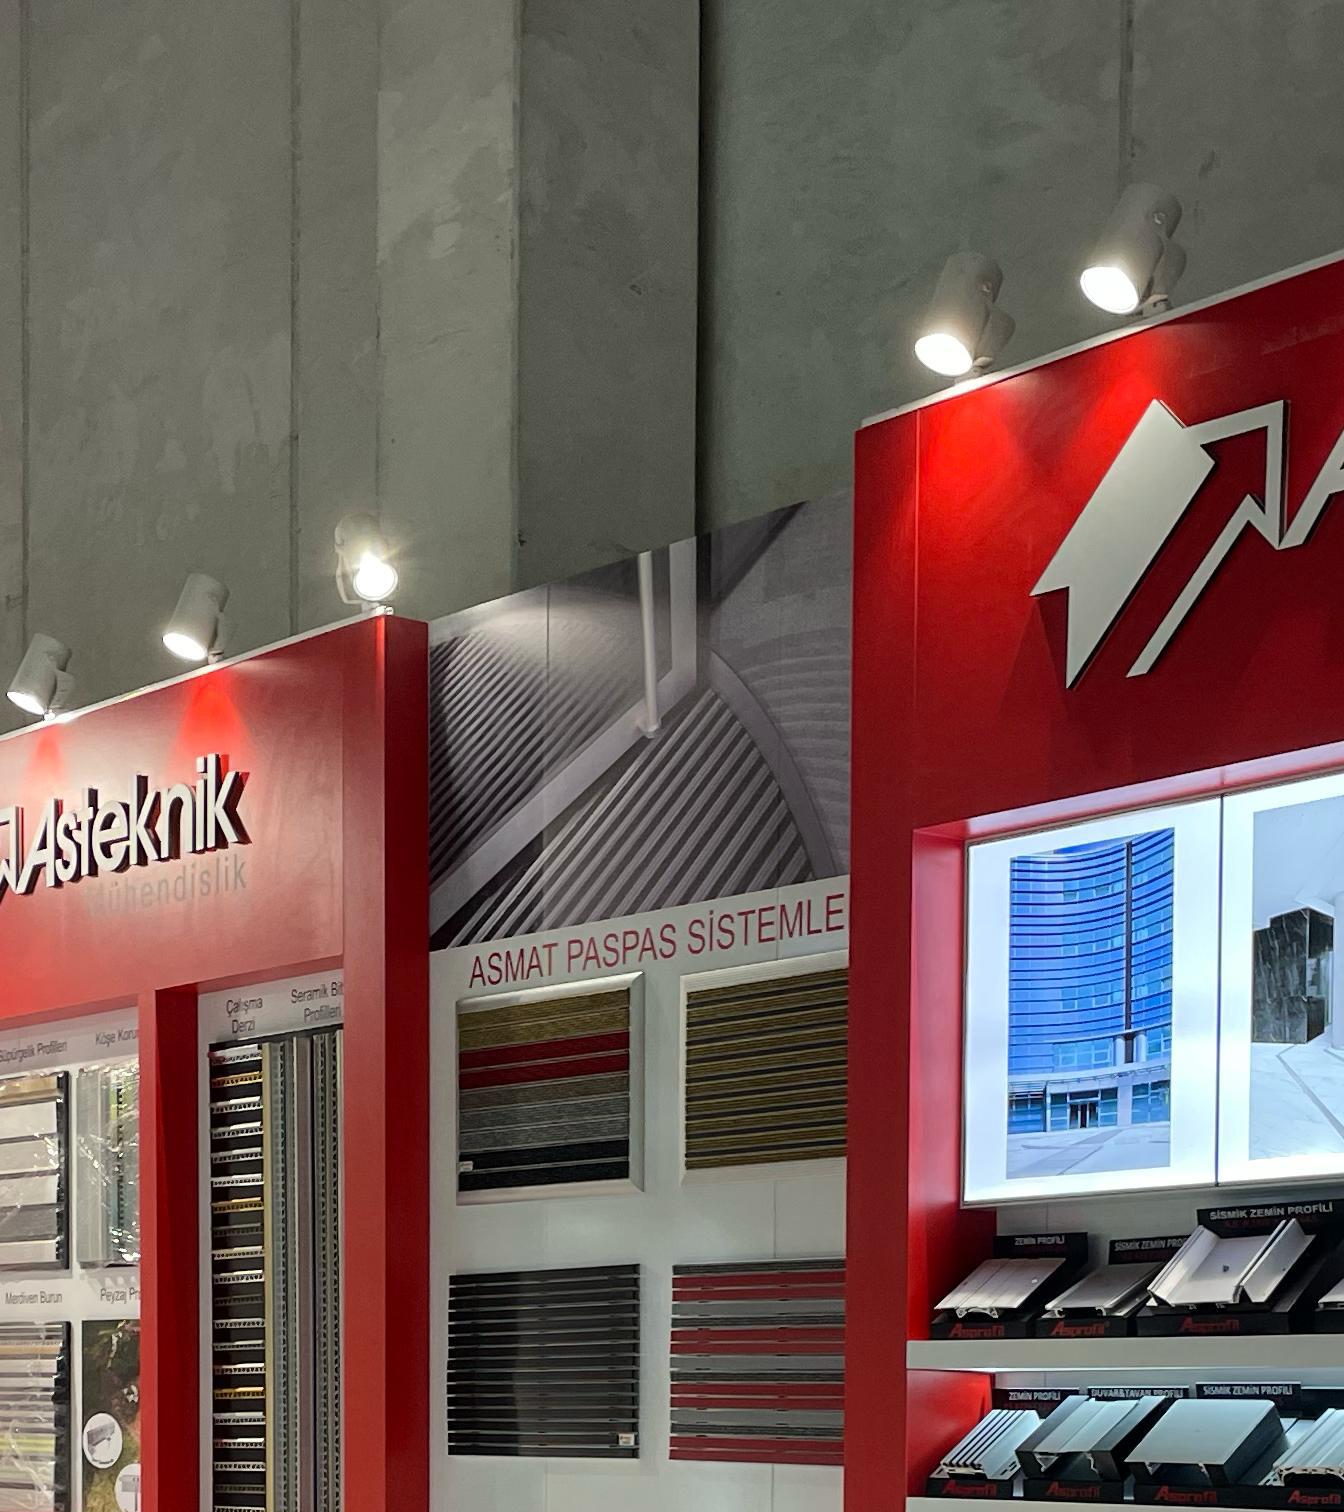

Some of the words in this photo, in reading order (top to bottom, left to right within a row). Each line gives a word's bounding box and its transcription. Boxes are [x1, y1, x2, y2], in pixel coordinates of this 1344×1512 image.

[15, 752, 248, 896] Asteknik
[468, 941, 560, 989] ASMAT
[567, 922, 678, 975] PASPAS
[686, 892, 846, 956] SİSTEMLE
[291, 983, 329, 1004] Seramik
[231, 1019, 256, 1033] Derzi
[1209, 1209, 1249, 1222] SİSMİK
[1249, 1205, 1285, 1218] ZEMİN
[1287, 1201, 1333, 1216] PROFİLİ
[1114, 1239, 1141, 1252] SİSMİK
[5, 1292, 39, 1305] Merdiven
[39, 1290, 63, 1304] Burun
[100, 1287, 127, 1305] Peyzaj
[948, 1321, 1005, 1339] Asprofil
[1050, 1319, 1106, 1337] Asprofil
[1008, 1390, 1033, 1401] ZEMİN
[1033, 1390, 1061, 1401] PROFİLİ
[1232, 1384, 1260, 1396] ZEMİN
[1260, 1384, 1293, 1396] PROFİLİ
